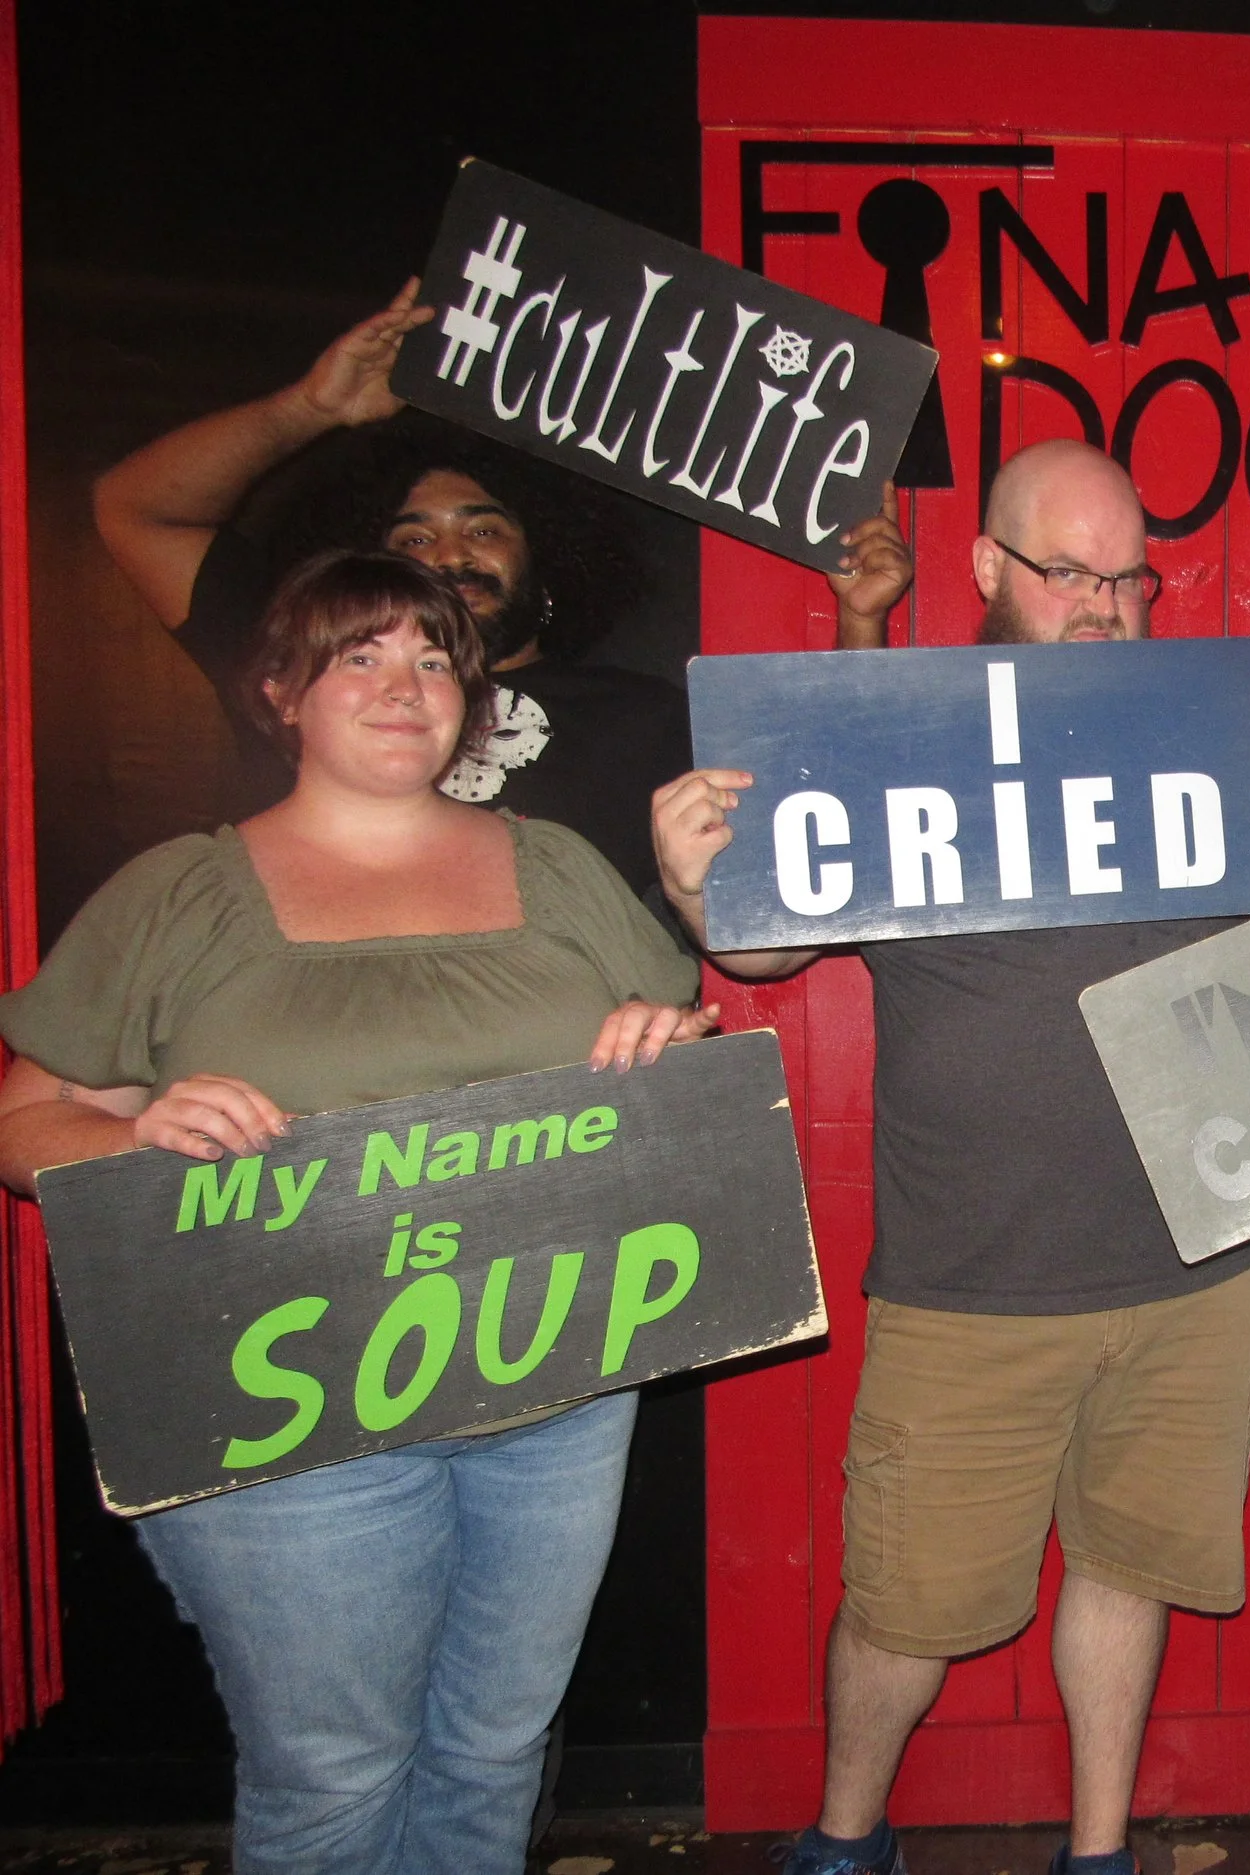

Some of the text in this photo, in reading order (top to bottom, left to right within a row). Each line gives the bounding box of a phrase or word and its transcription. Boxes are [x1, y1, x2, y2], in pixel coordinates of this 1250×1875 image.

[987, 662, 1021, 764] I
[773, 772, 1227, 916] CRIED
[175, 1105, 619, 1232] My Name
[383, 1212, 463, 1278] is
[221, 1222, 701, 1469] SOUP
